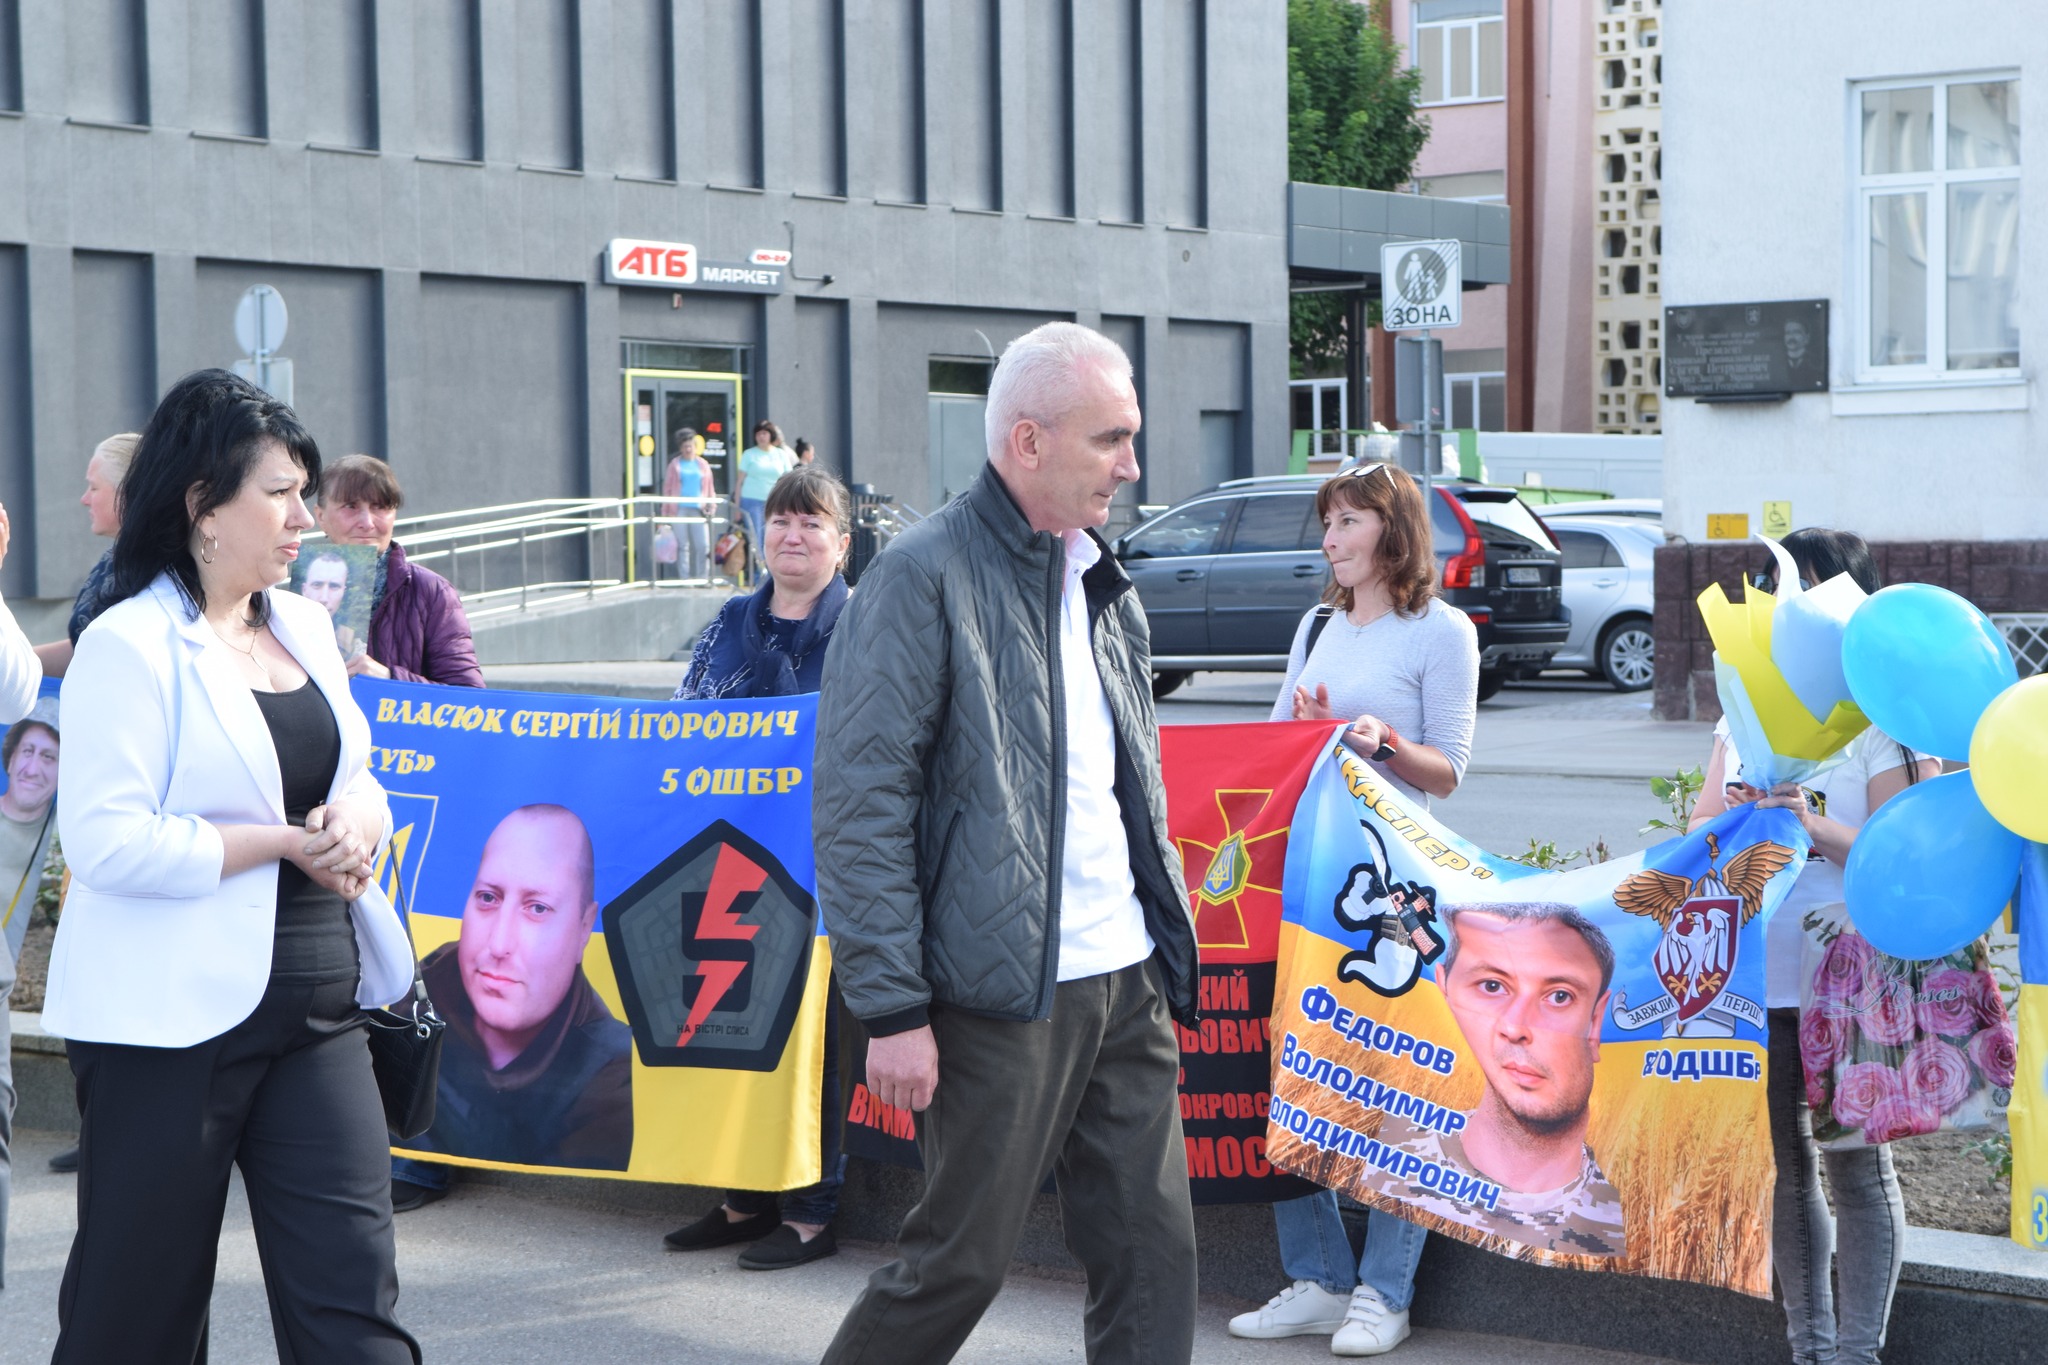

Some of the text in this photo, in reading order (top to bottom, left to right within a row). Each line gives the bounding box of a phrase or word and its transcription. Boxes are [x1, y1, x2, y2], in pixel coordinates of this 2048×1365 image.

[618, 246, 689, 278] АТБ
[703, 266, 780, 286] МАРКЕТ
[1392, 305, 1452, 325] ЗОНА
[376, 697, 799, 741] ВЛАСЮК СЕРГІЙ ІГОРОВИЧ
[659, 766, 803, 796] 5 ОШБР
[1627, 997, 1675, 1026] ЗАВЖДИ
[677, 1024, 691, 1034] НА
[695, 1024, 724, 1035] ВІСТРІ
[1184, 1135, 1288, 1178] МОС
[1269, 1095, 1503, 1211] ОЛОДИМИРОВИЧ
